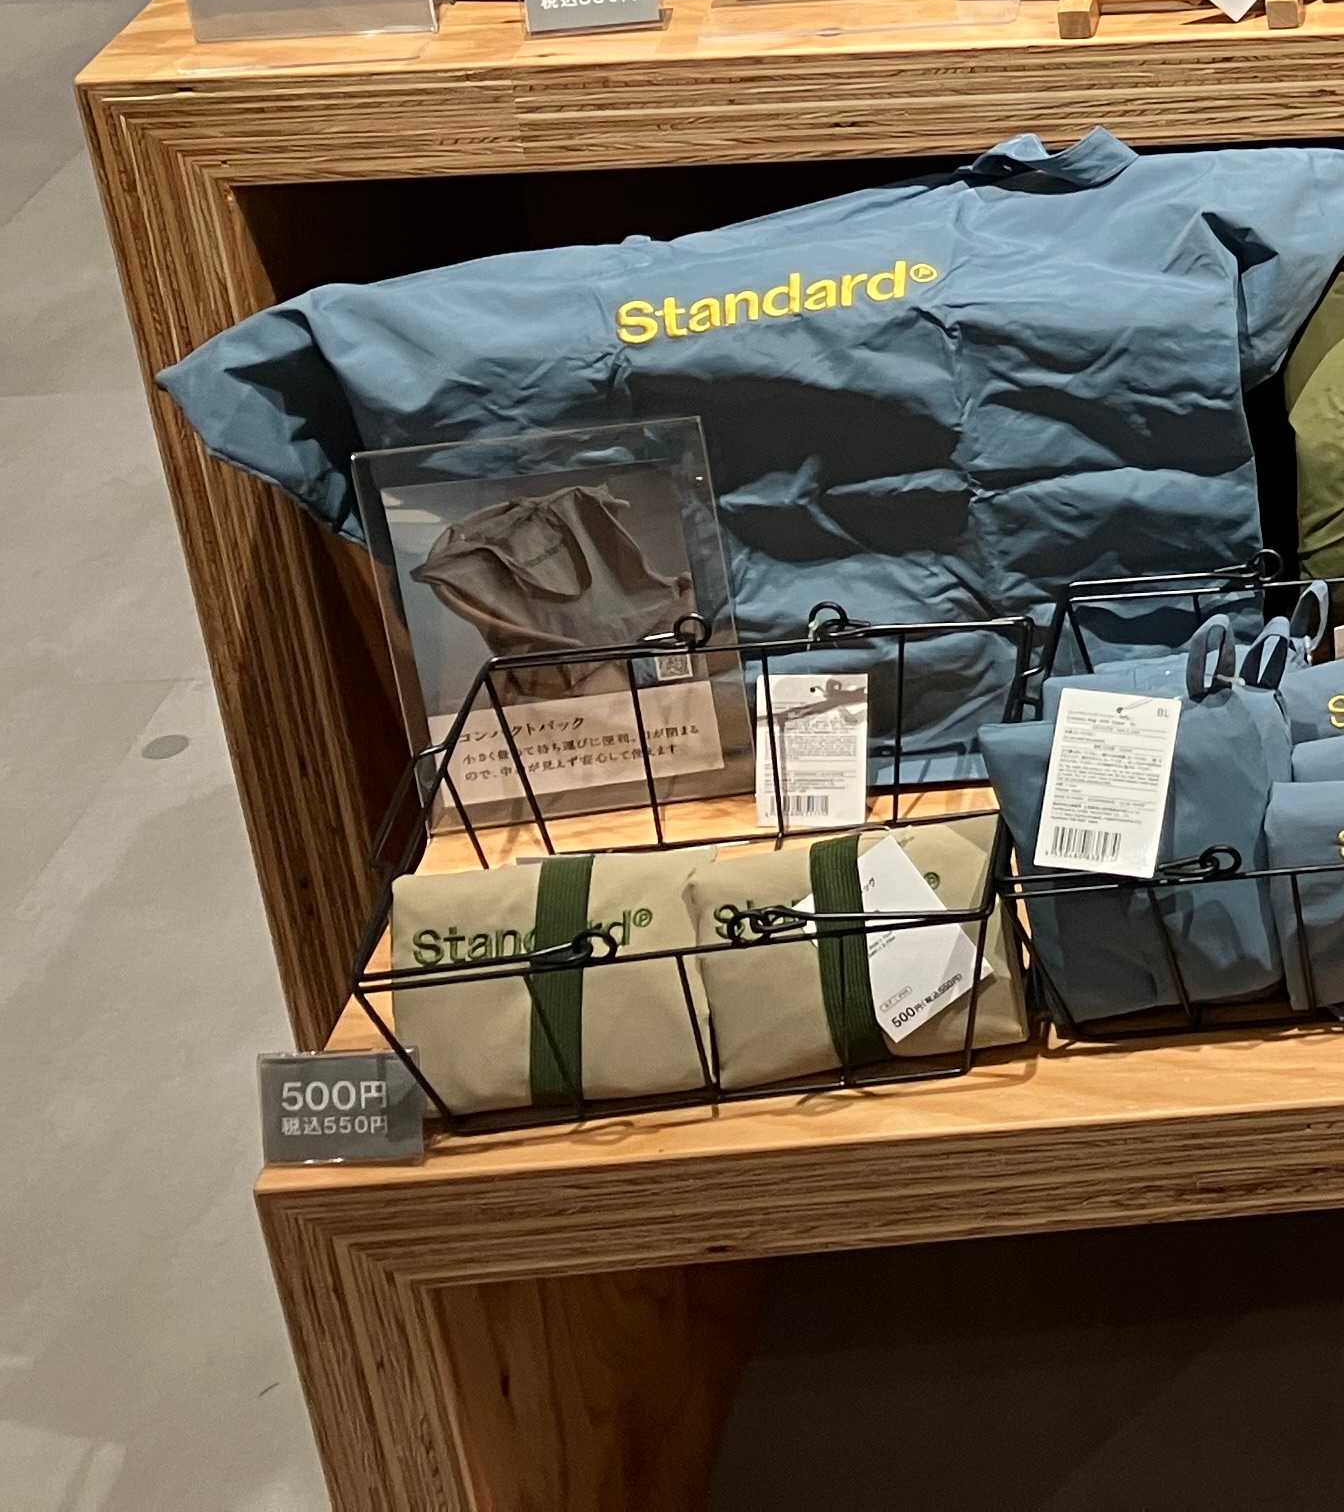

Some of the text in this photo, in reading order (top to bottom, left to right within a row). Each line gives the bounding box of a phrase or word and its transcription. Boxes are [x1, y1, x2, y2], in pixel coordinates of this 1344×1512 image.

[281, 1080, 387, 1111] 500円
[280, 1115, 388, 1136] 税込550円
